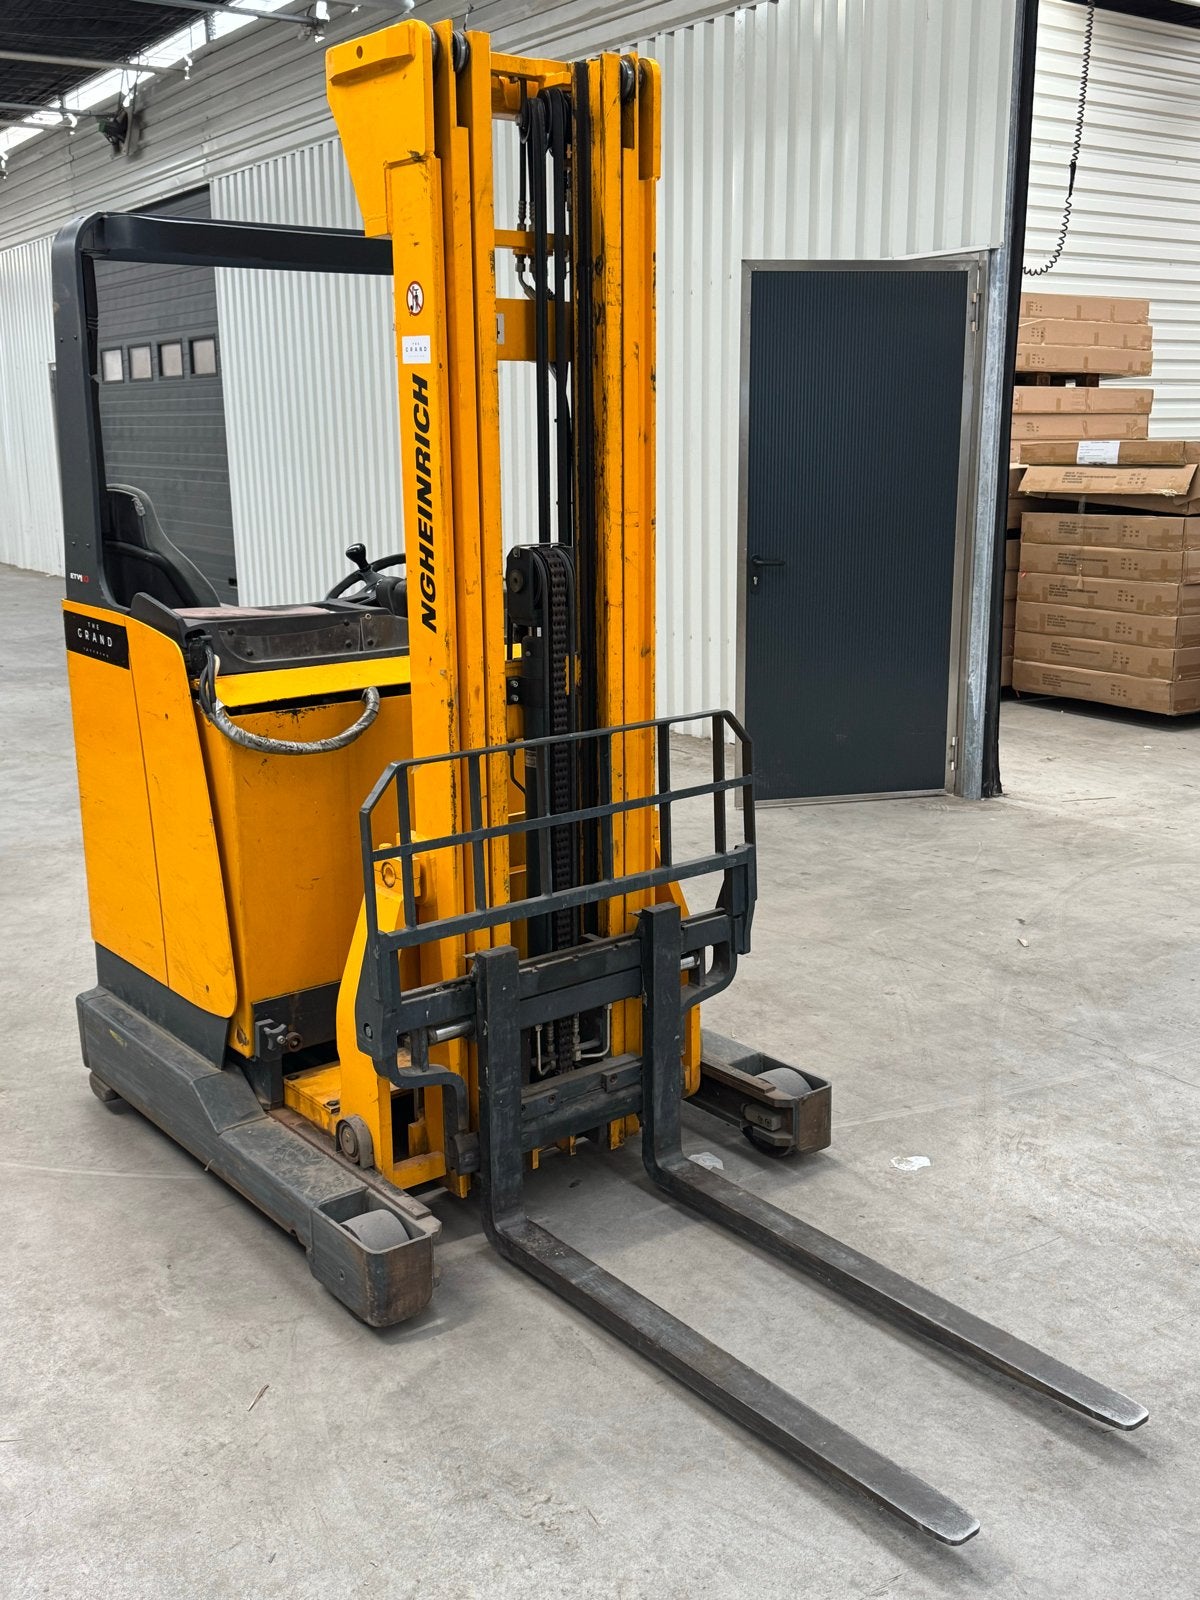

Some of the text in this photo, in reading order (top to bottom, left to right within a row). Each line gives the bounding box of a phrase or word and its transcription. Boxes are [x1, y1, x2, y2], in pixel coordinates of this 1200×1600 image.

[412, 373, 437, 634] NGHEINRICH
[87, 621, 100, 631] THE
[77, 627, 113, 648] GRAND
